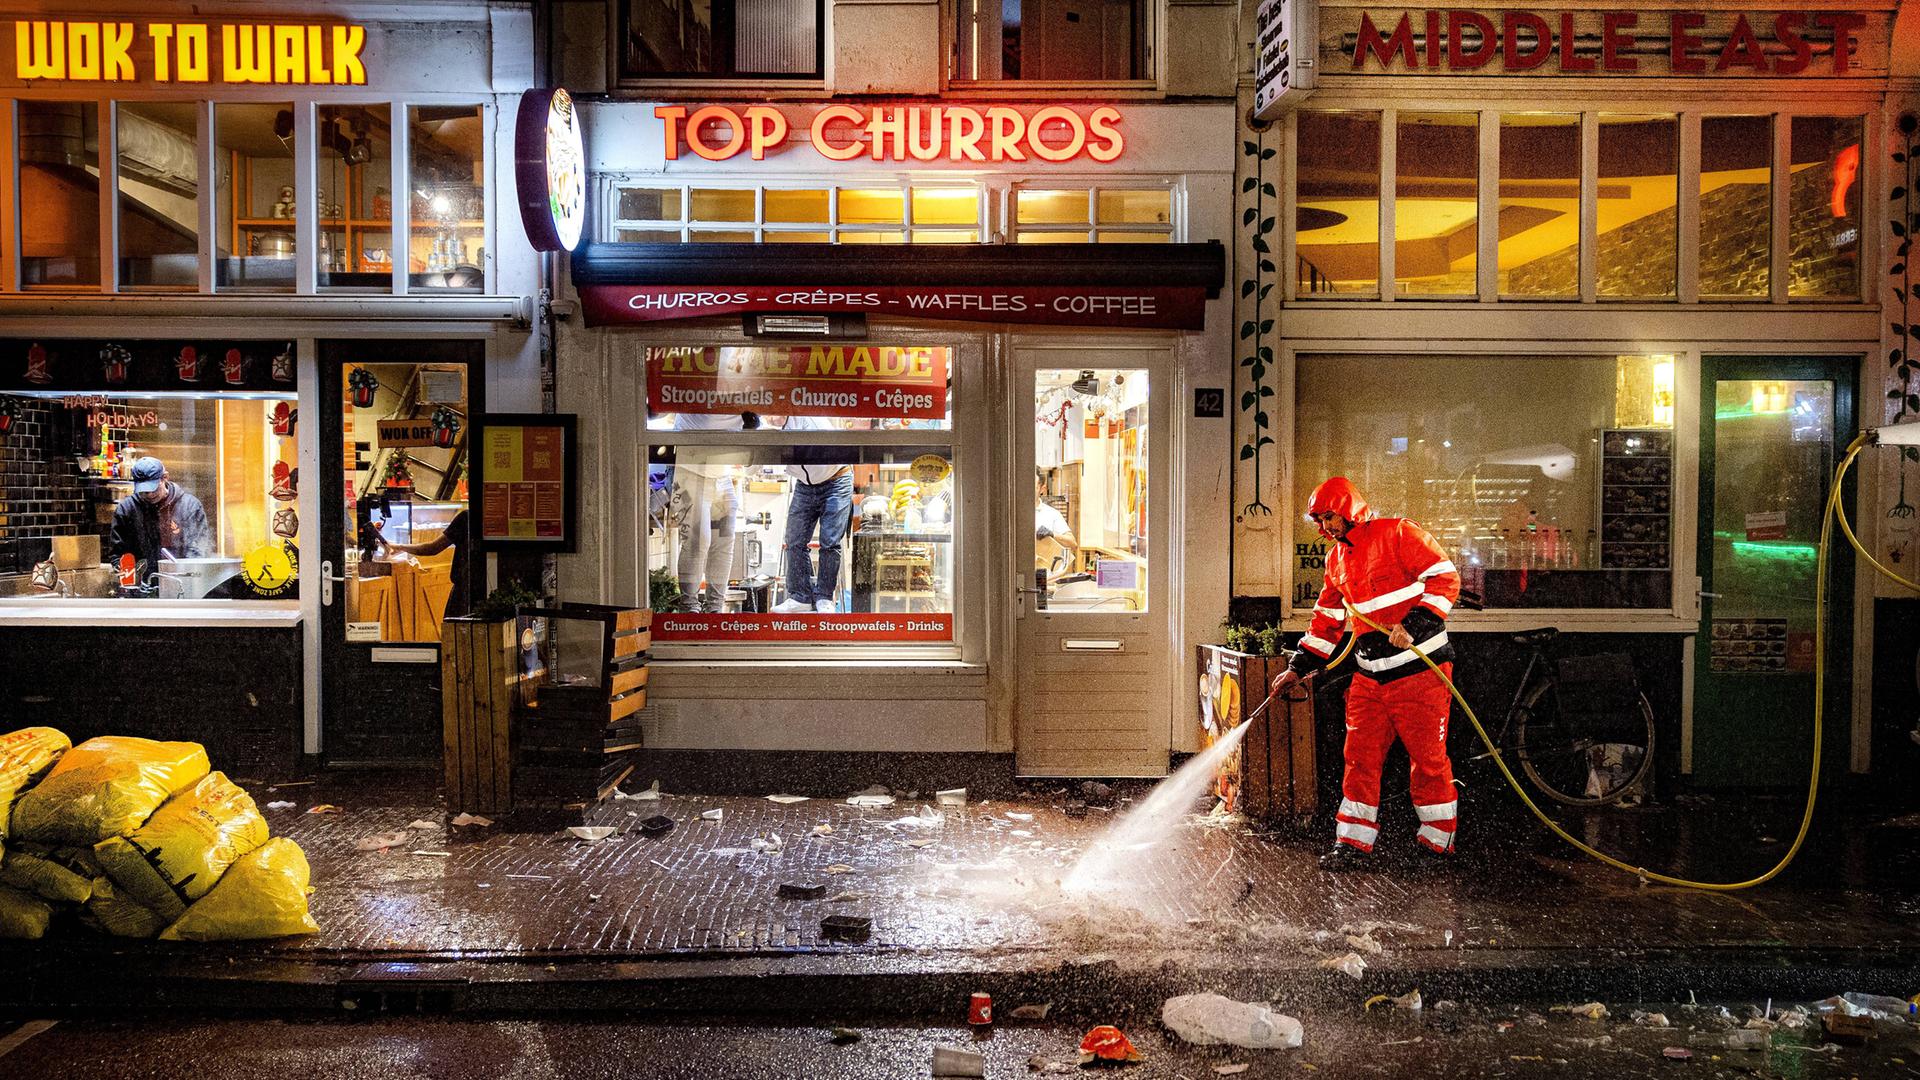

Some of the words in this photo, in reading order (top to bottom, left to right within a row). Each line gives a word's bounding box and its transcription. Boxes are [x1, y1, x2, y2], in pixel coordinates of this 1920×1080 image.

[15, 21, 136, 81] WOK
[149, 23, 209, 82] TO
[222, 24, 367, 84] WALK
[1351, 10, 1639, 71] MIDDLE
[1670, 12, 1868, 74] EAST
[654, 105, 787, 161] TOP
[809, 105, 1124, 162] CHURROS
[628, 292, 750, 309] CHURROS
[775, 289, 881, 306] CRÊPES
[906, 294, 1028, 312] WAFFLES
[1053, 296, 1156, 315] COFFEE
[805, 346, 932, 377] MADE
[64, 394, 109, 409] HAPPY
[661, 384, 773, 409] Stroopwafels
[790, 387, 858, 408] Churros
[875, 388, 933, 413] Crêpes
[1196, 393, 1221, 411] 42
[87, 411, 158, 427] HOLIDAYS!
[380, 426, 409, 441] WOK
[1296, 543, 1327, 556] HAL
[663, 620, 709, 632] Churros
[720, 620, 760, 634] Crêpes
[771, 620, 808, 631] Waffle
[819, 620, 896, 634] Stroopwafels
[906, 620, 944, 632] Drinks
